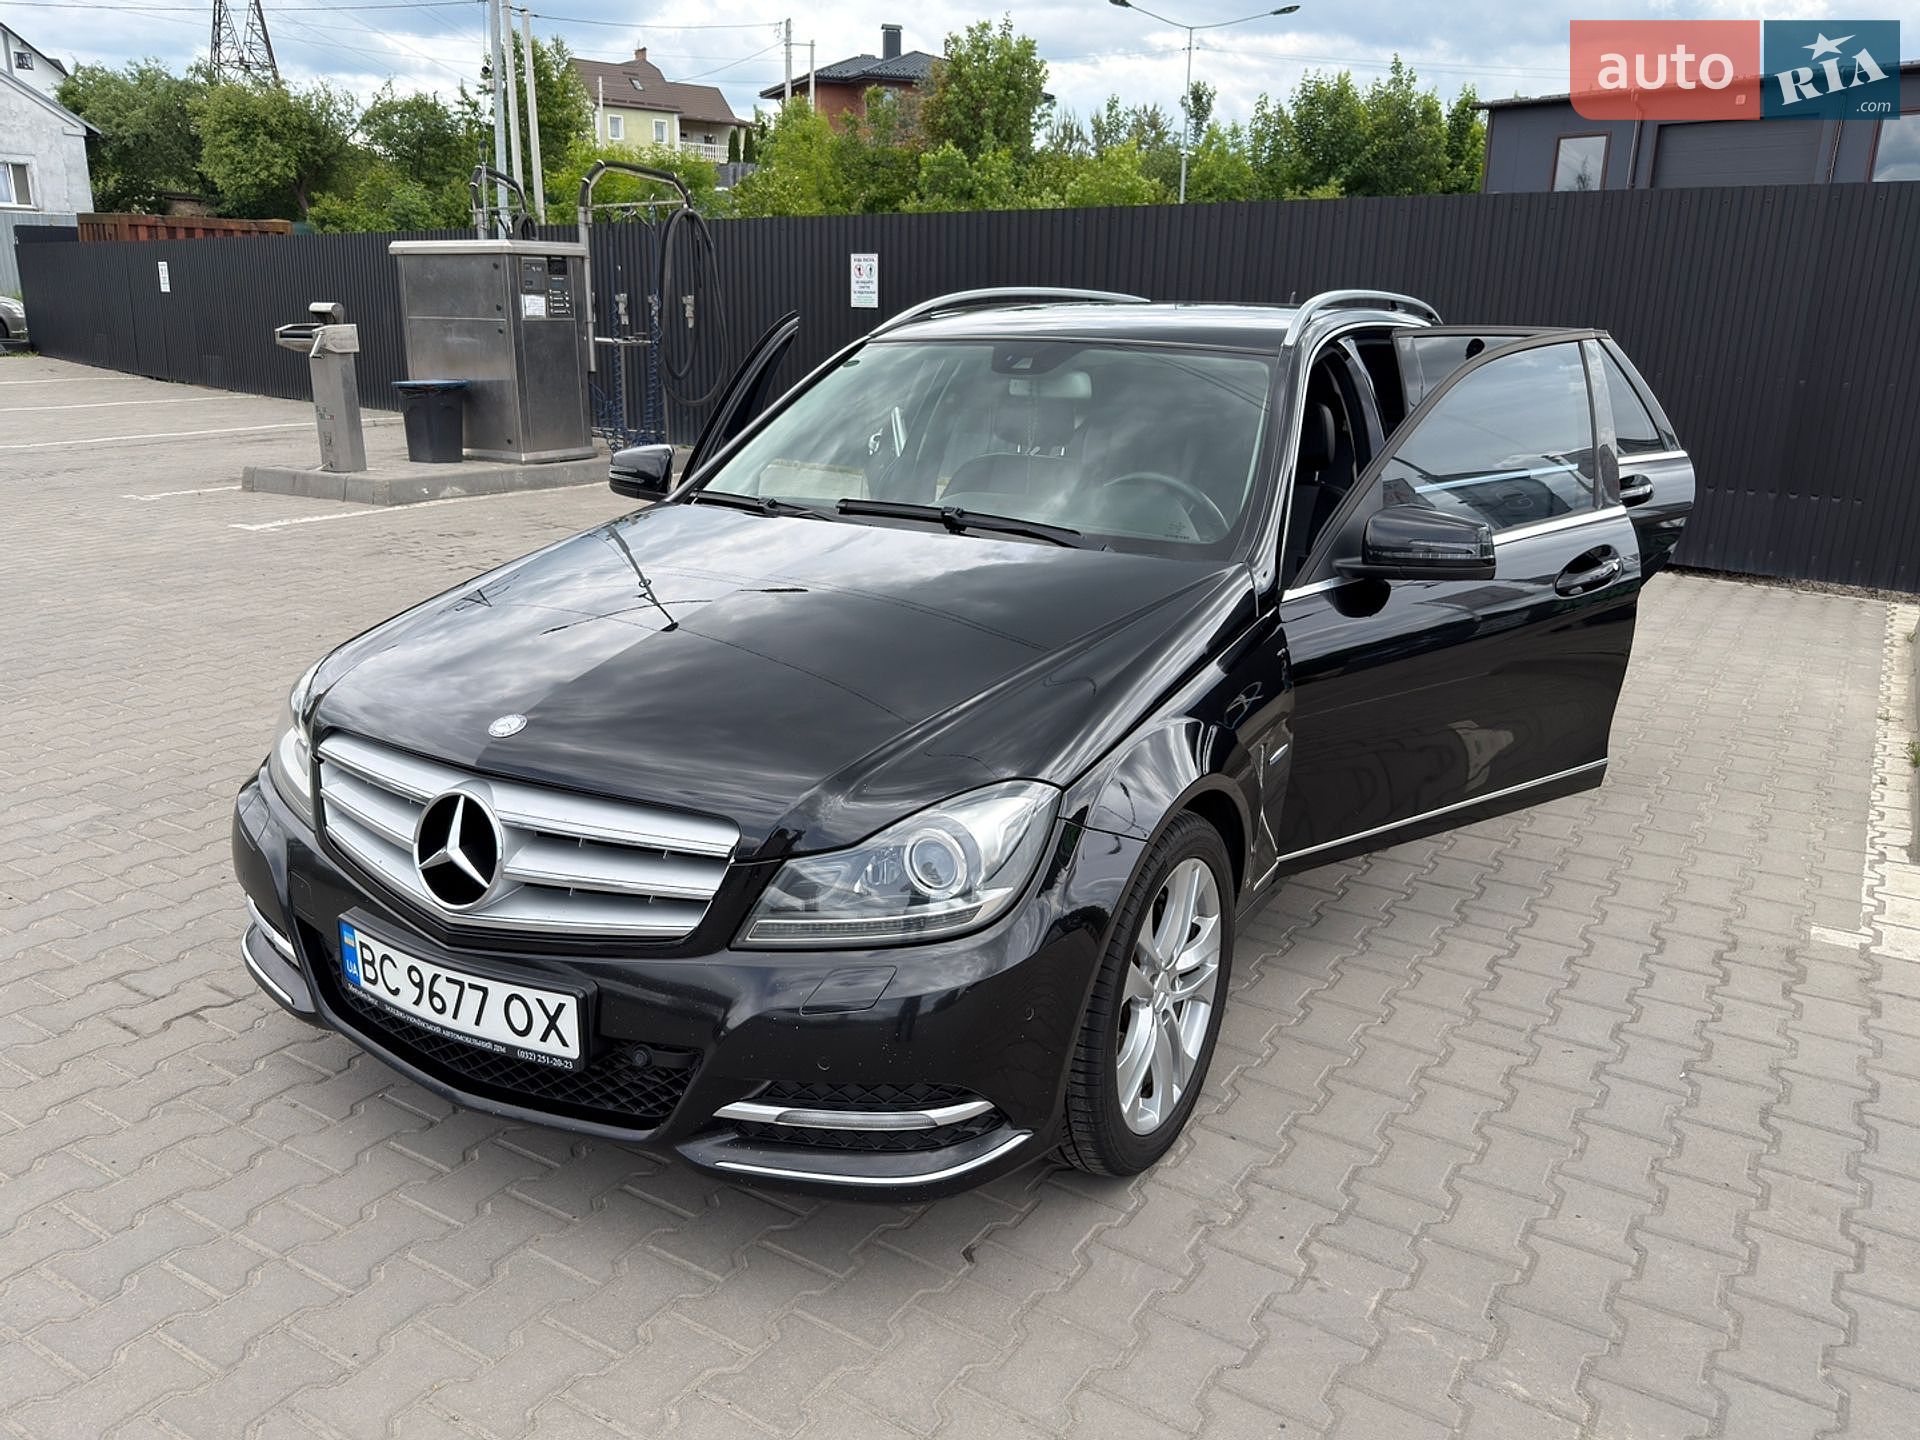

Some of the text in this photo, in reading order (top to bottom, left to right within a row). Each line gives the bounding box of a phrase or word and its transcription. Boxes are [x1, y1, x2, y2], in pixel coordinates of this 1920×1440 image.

[347, 962, 359, 977] UA
[359, 940, 400, 996] BC
[406, 964, 489, 1027] 9677
[503, 992, 570, 1048] OX
